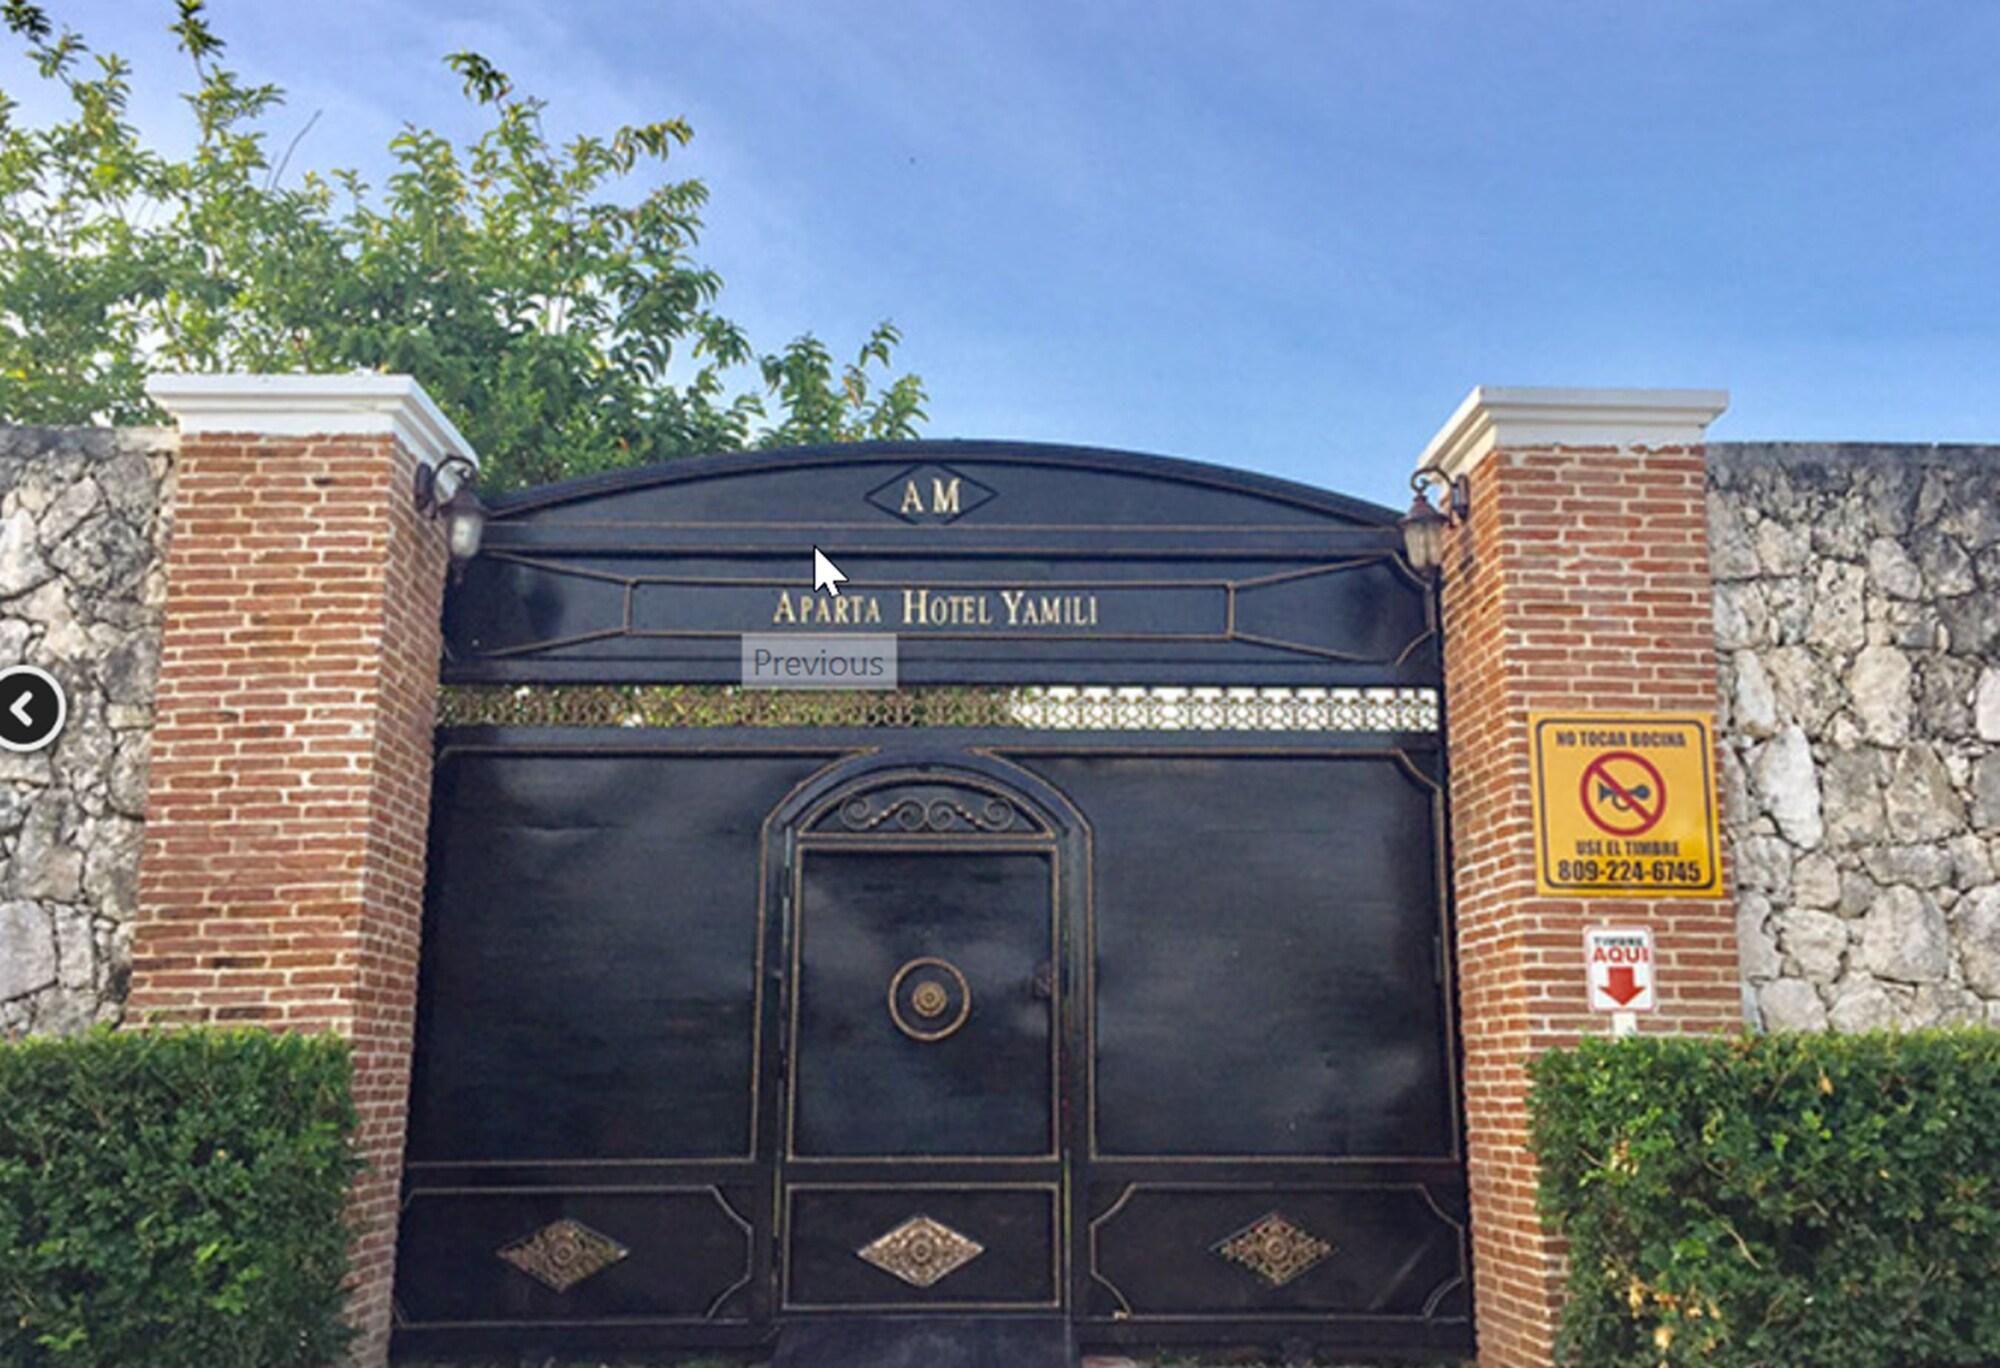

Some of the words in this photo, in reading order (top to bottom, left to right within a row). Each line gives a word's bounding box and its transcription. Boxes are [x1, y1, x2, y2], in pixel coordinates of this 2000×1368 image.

[773, 590, 882, 624] APARTA
[902, 589, 993, 625] HOTEL
[1001, 590, 1098, 626] YAMILI
[1556, 731, 1576, 746] NO
[1580, 731, 1627, 746] TOCAR
[1631, 731, 1686, 747] BOCINA
[1575, 841, 1604, 856] USE
[1606, 841, 1620, 856] EL
[1624, 841, 1680, 857] TIMBRE
[1558, 860, 1700, 882] 809-224-6745
